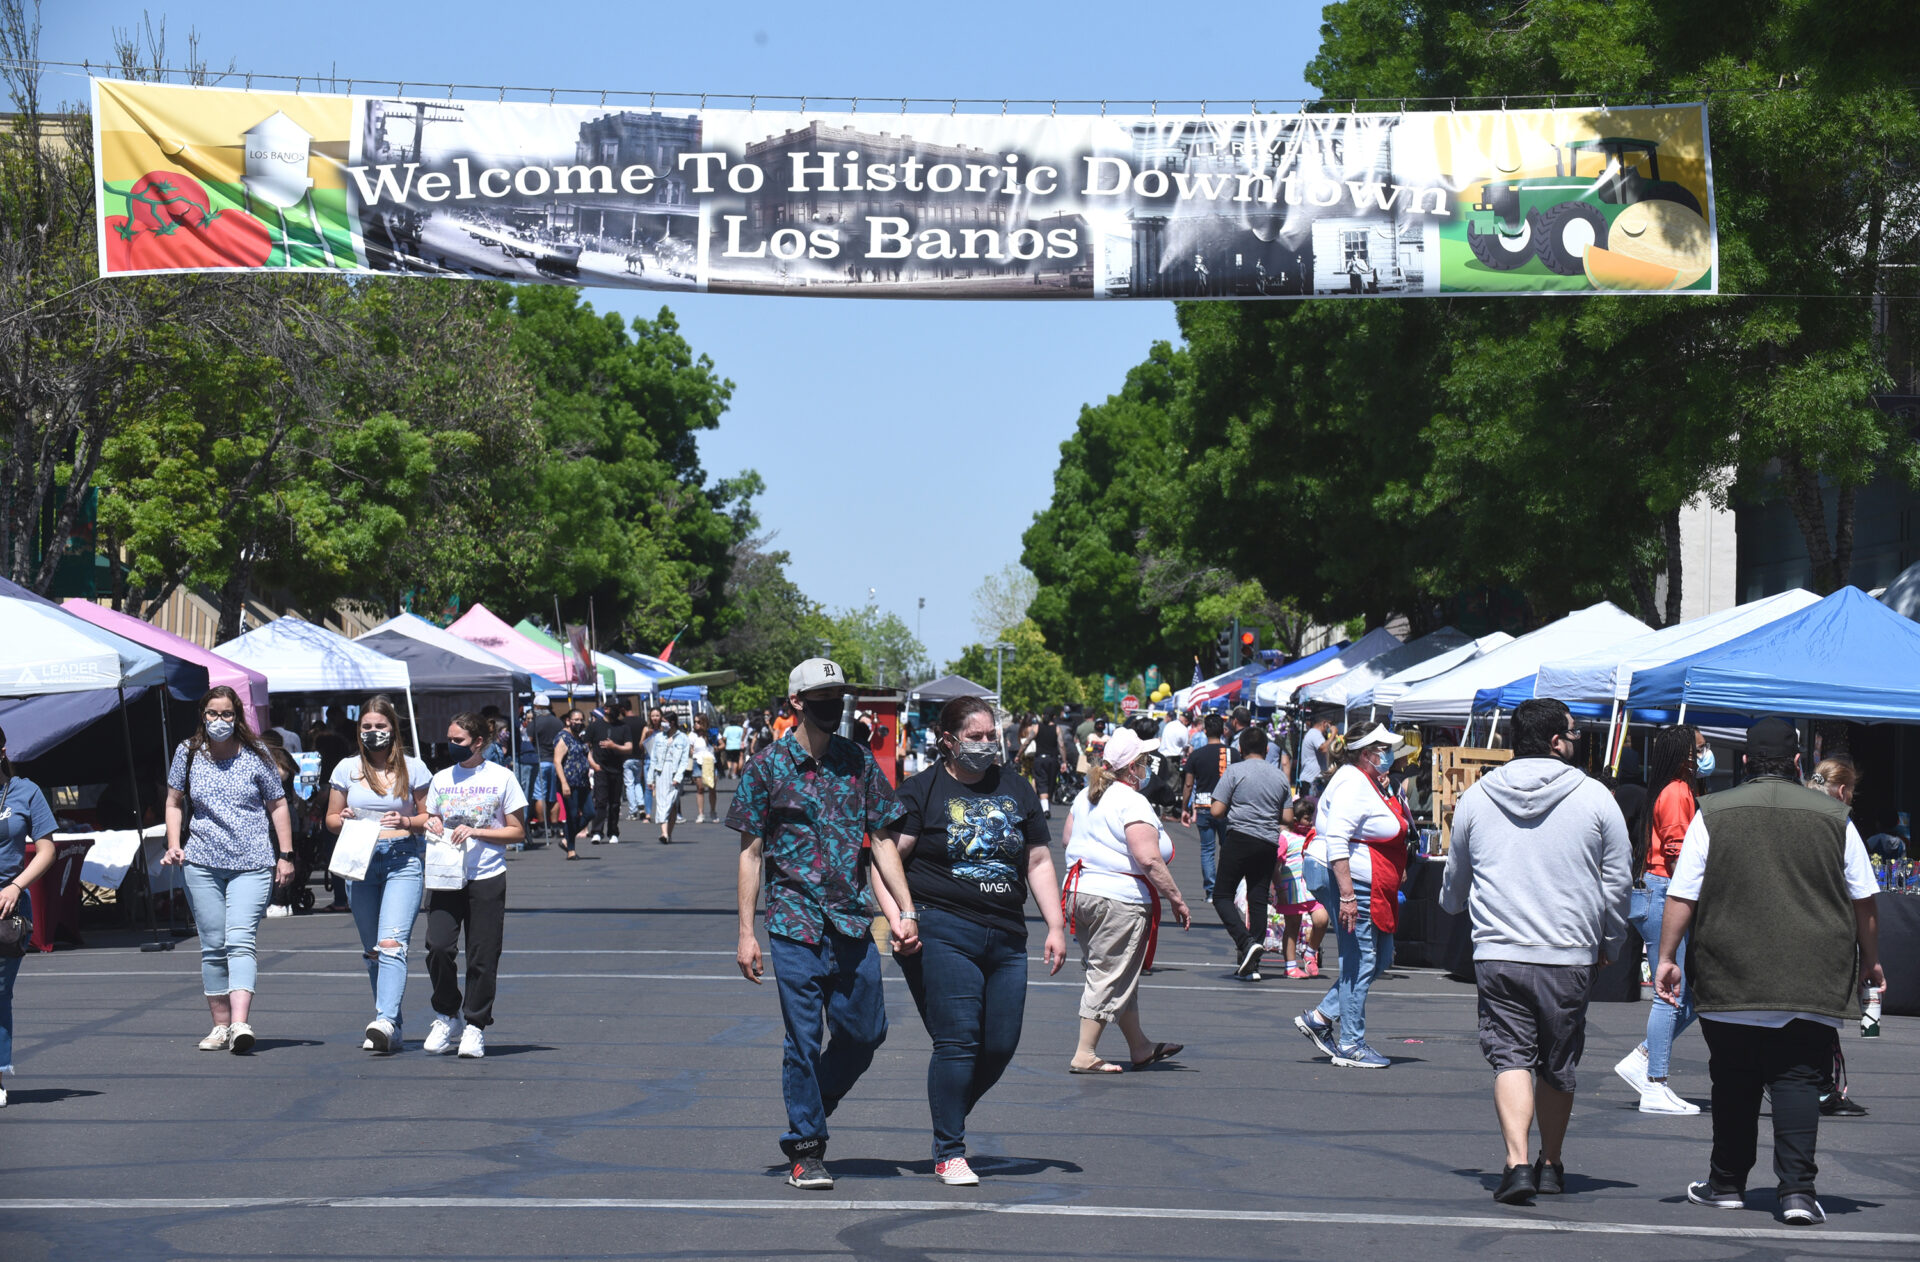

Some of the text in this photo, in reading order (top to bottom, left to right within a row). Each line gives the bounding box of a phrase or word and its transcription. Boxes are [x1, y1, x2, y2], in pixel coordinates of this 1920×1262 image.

[250, 150, 305, 161] LOS BANOS
[349, 150, 1451, 216] Welcome To Historic Downtown
[722, 215, 1079, 260] Los Banos
[42, 662, 98, 677] LEADER
[439, 786, 499, 795] CHILL SINCE
[980, 882, 1011, 893] NASA
[794, 1140, 818, 1150] didas
